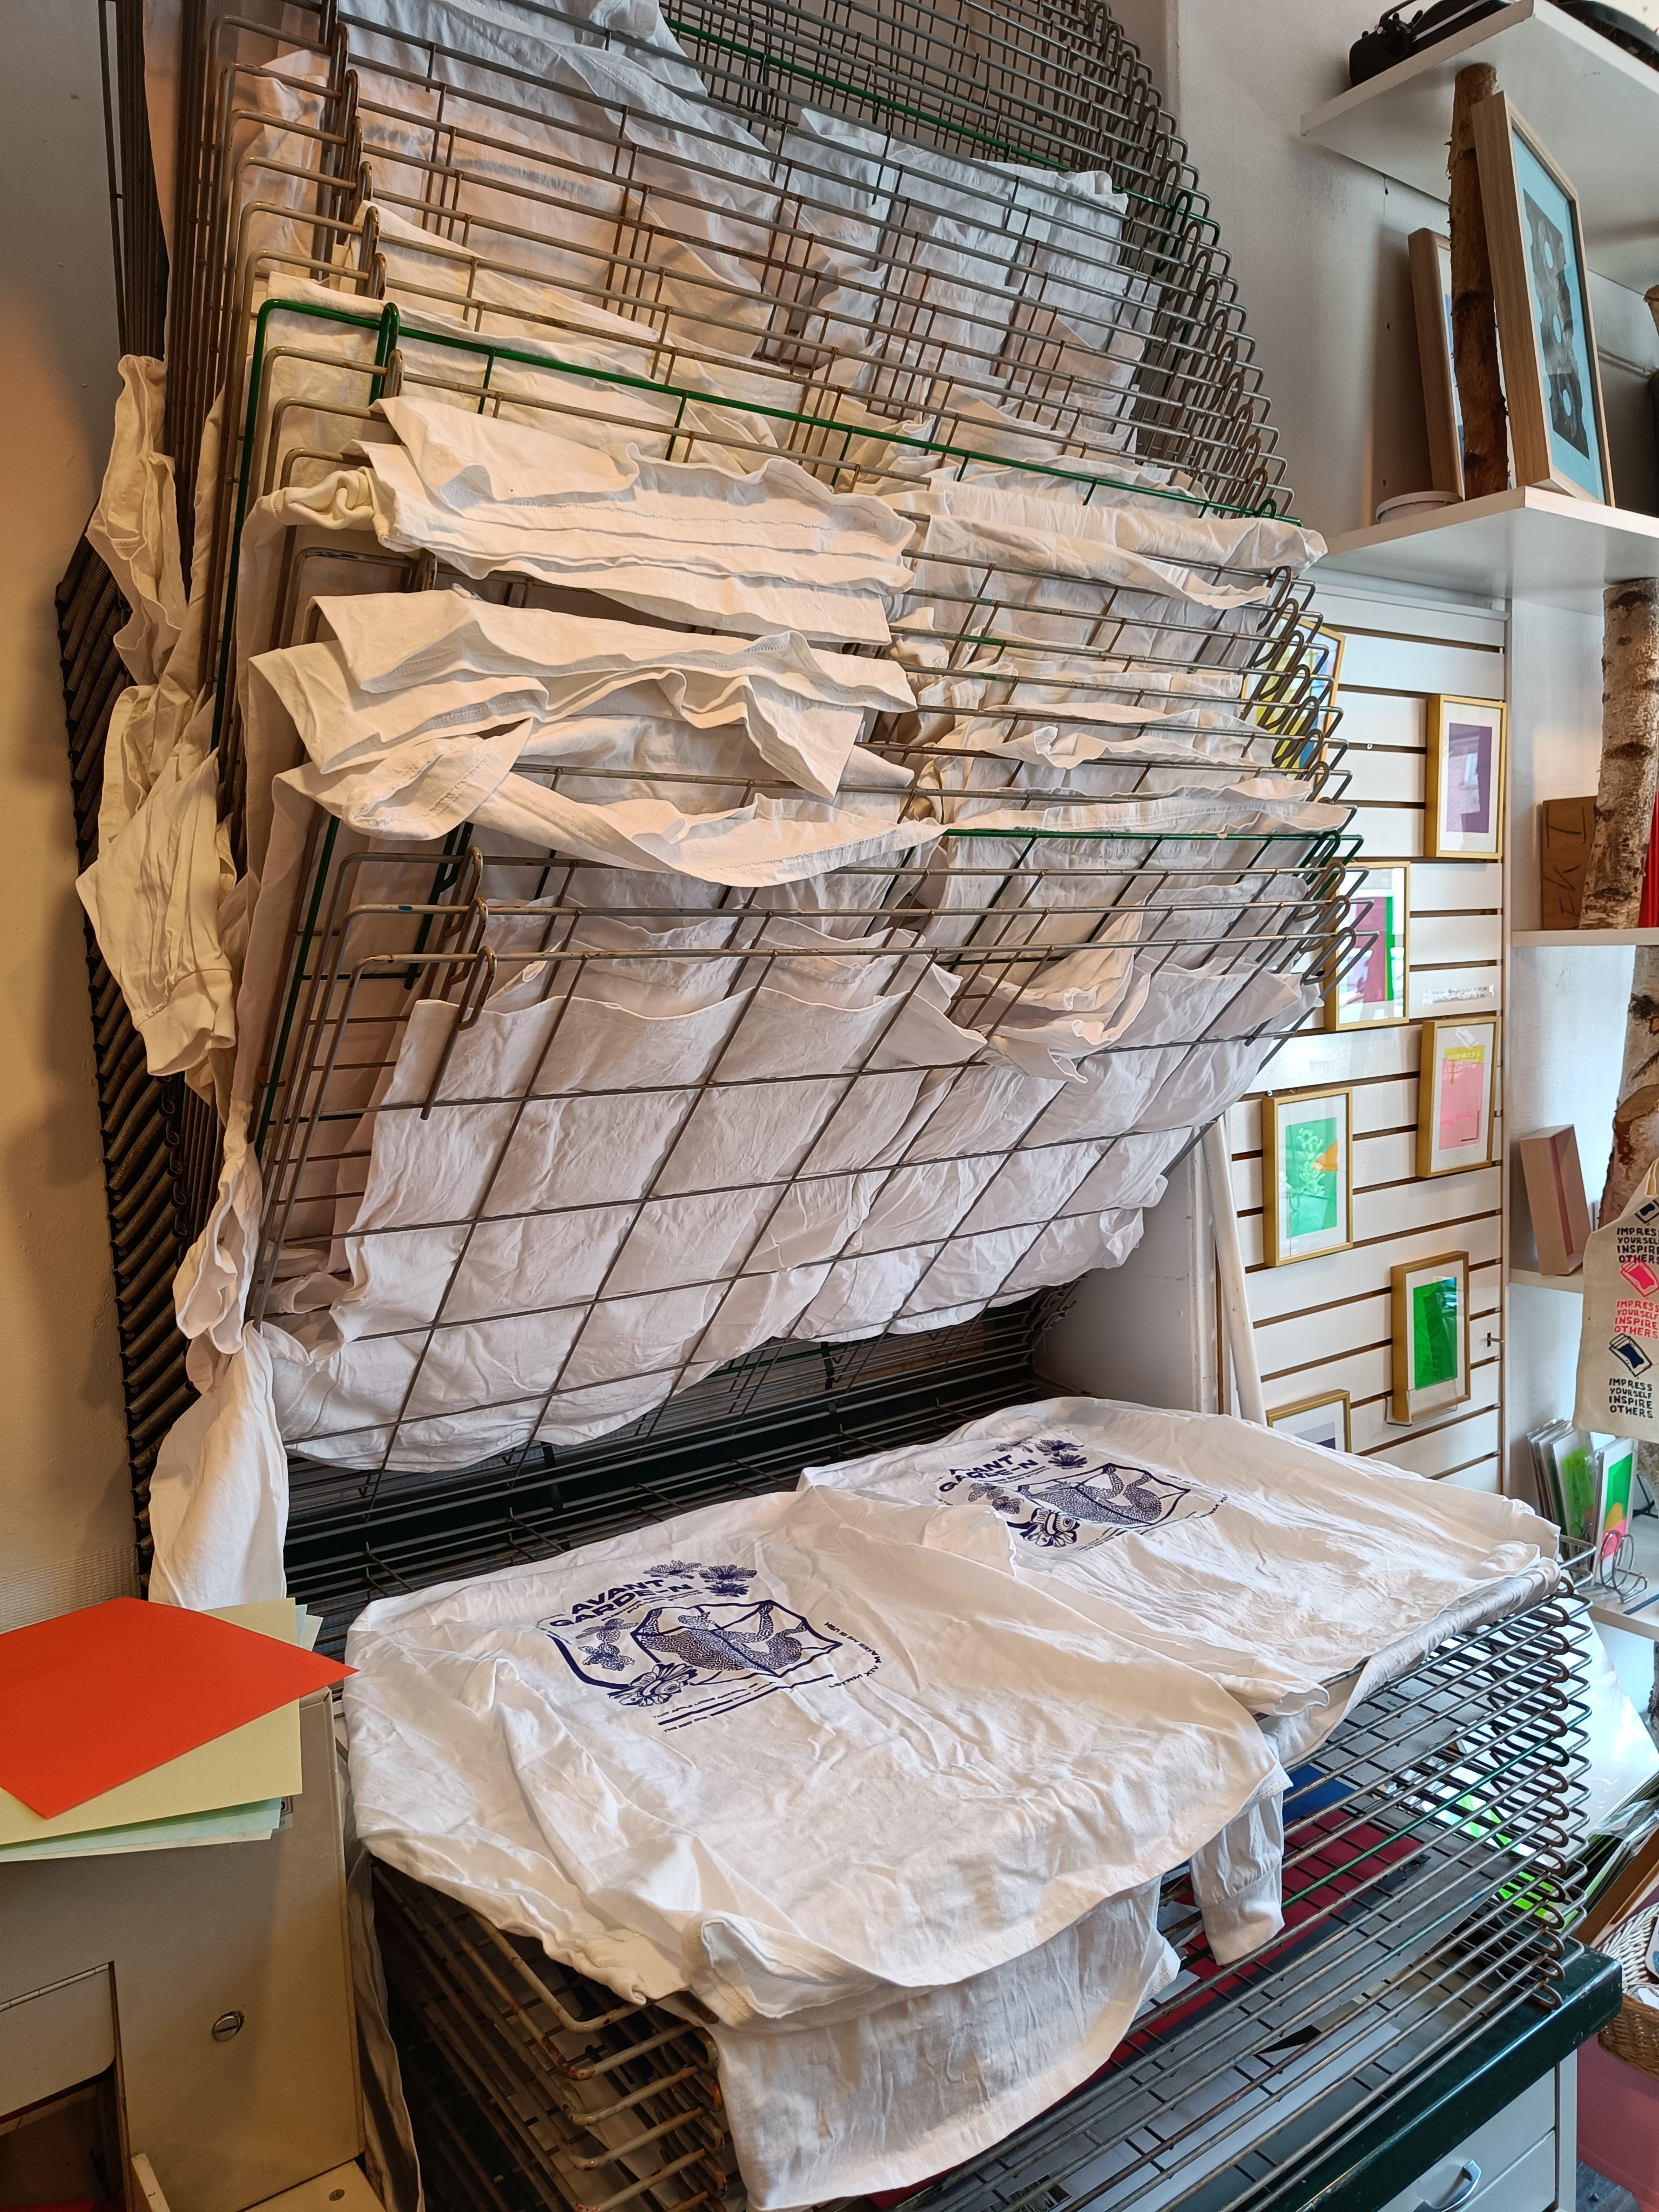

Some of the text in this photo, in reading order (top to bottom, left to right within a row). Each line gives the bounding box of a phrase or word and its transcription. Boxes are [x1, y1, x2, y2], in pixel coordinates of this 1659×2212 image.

[1617, 1237, 1659, 1245] YOURSEL
[1616, 1300, 1659, 1312] IMPRESS
[1617, 1309, 1658, 1320] YOURSELF
[1615, 1317, 1658, 1330] INSPIRE
[1614, 1326, 1658, 1339] OTHERS
[1609, 1378, 1653, 1391] IMPRESS
[1610, 1387, 1652, 1399] YOURSELF
[1609, 1395, 1653, 1410] INSPIRE
[1610, 1405, 1653, 1419] OTHERS
[949, 1454, 1014, 1475] ANT
[572, 1579, 664, 1614] AVANT
[549, 1584, 693, 1627] GARDE-N
